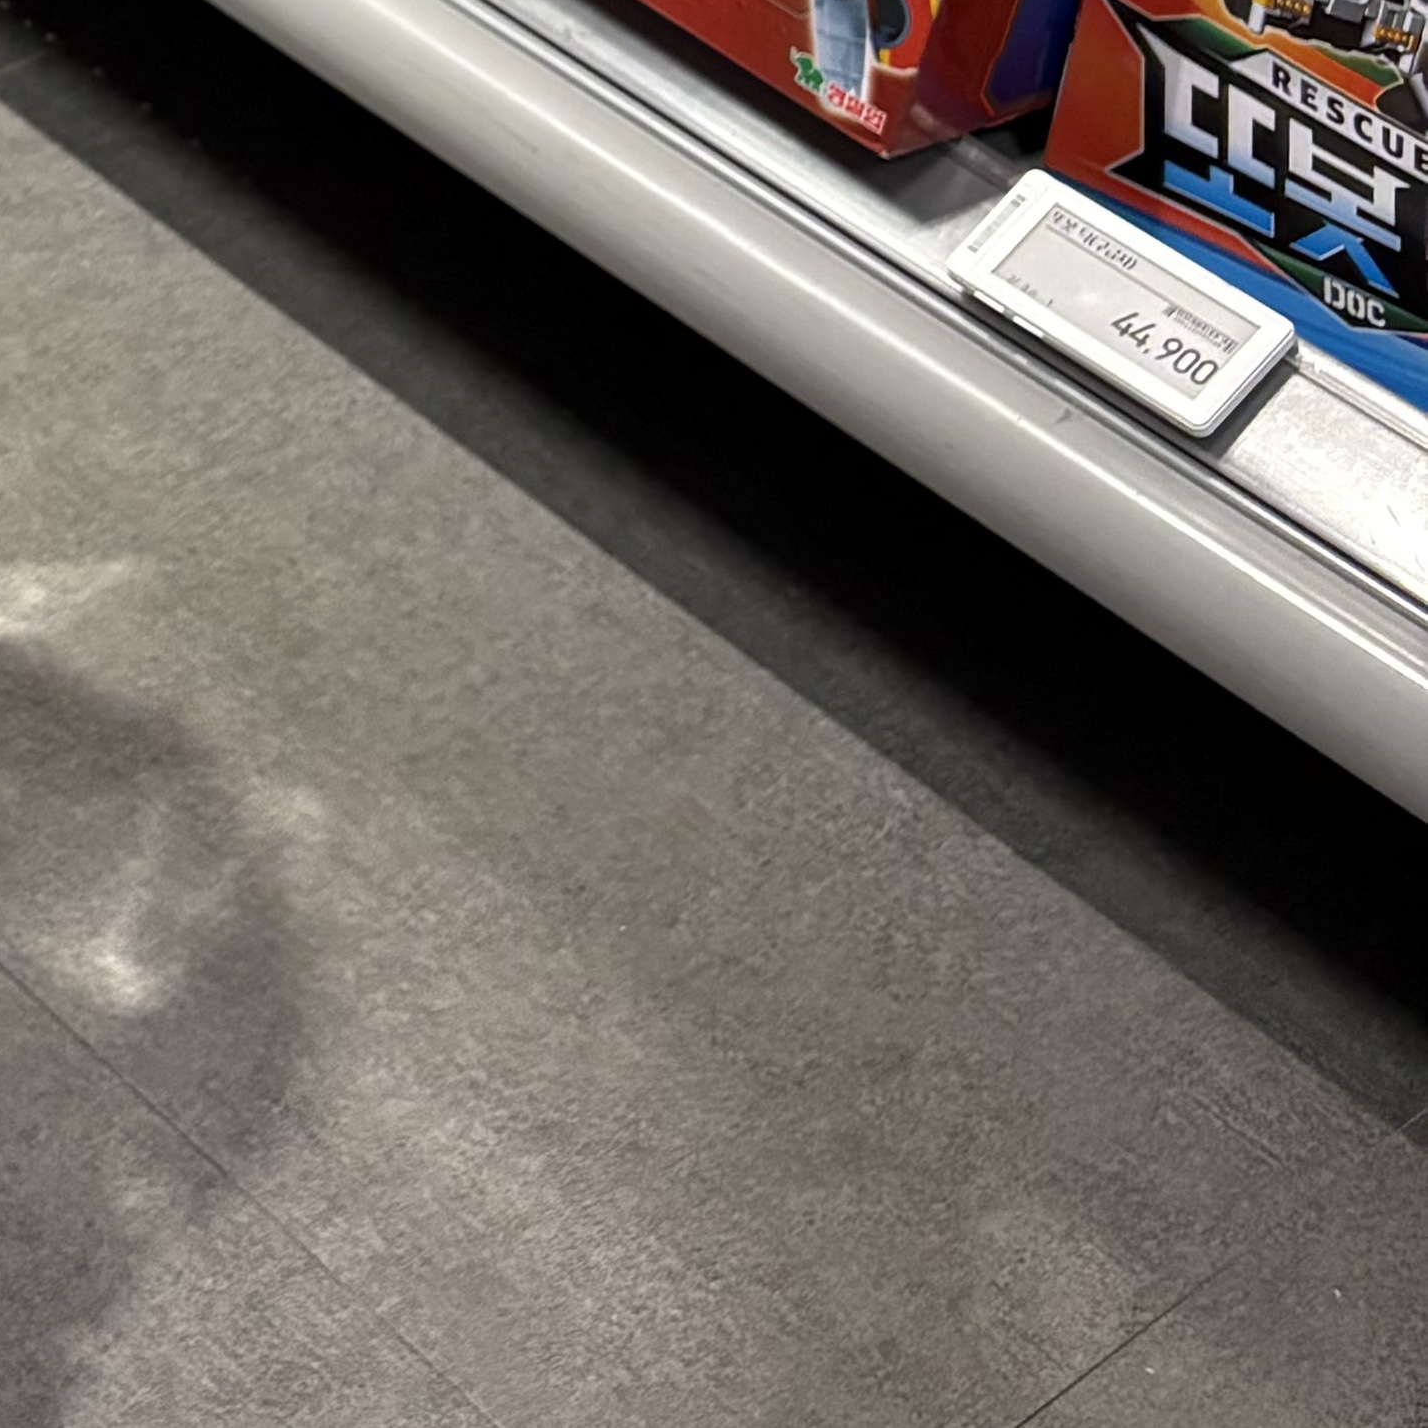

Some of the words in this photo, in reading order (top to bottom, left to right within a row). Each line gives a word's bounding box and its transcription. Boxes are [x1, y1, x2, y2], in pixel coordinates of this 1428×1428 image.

[1137, 23, 1411, 298] 또봇
[1272, 60, 1428, 173] RESCUE
[1323, 274, 1387, 328] DOC
[1109, 311, 1219, 386] 44,900
